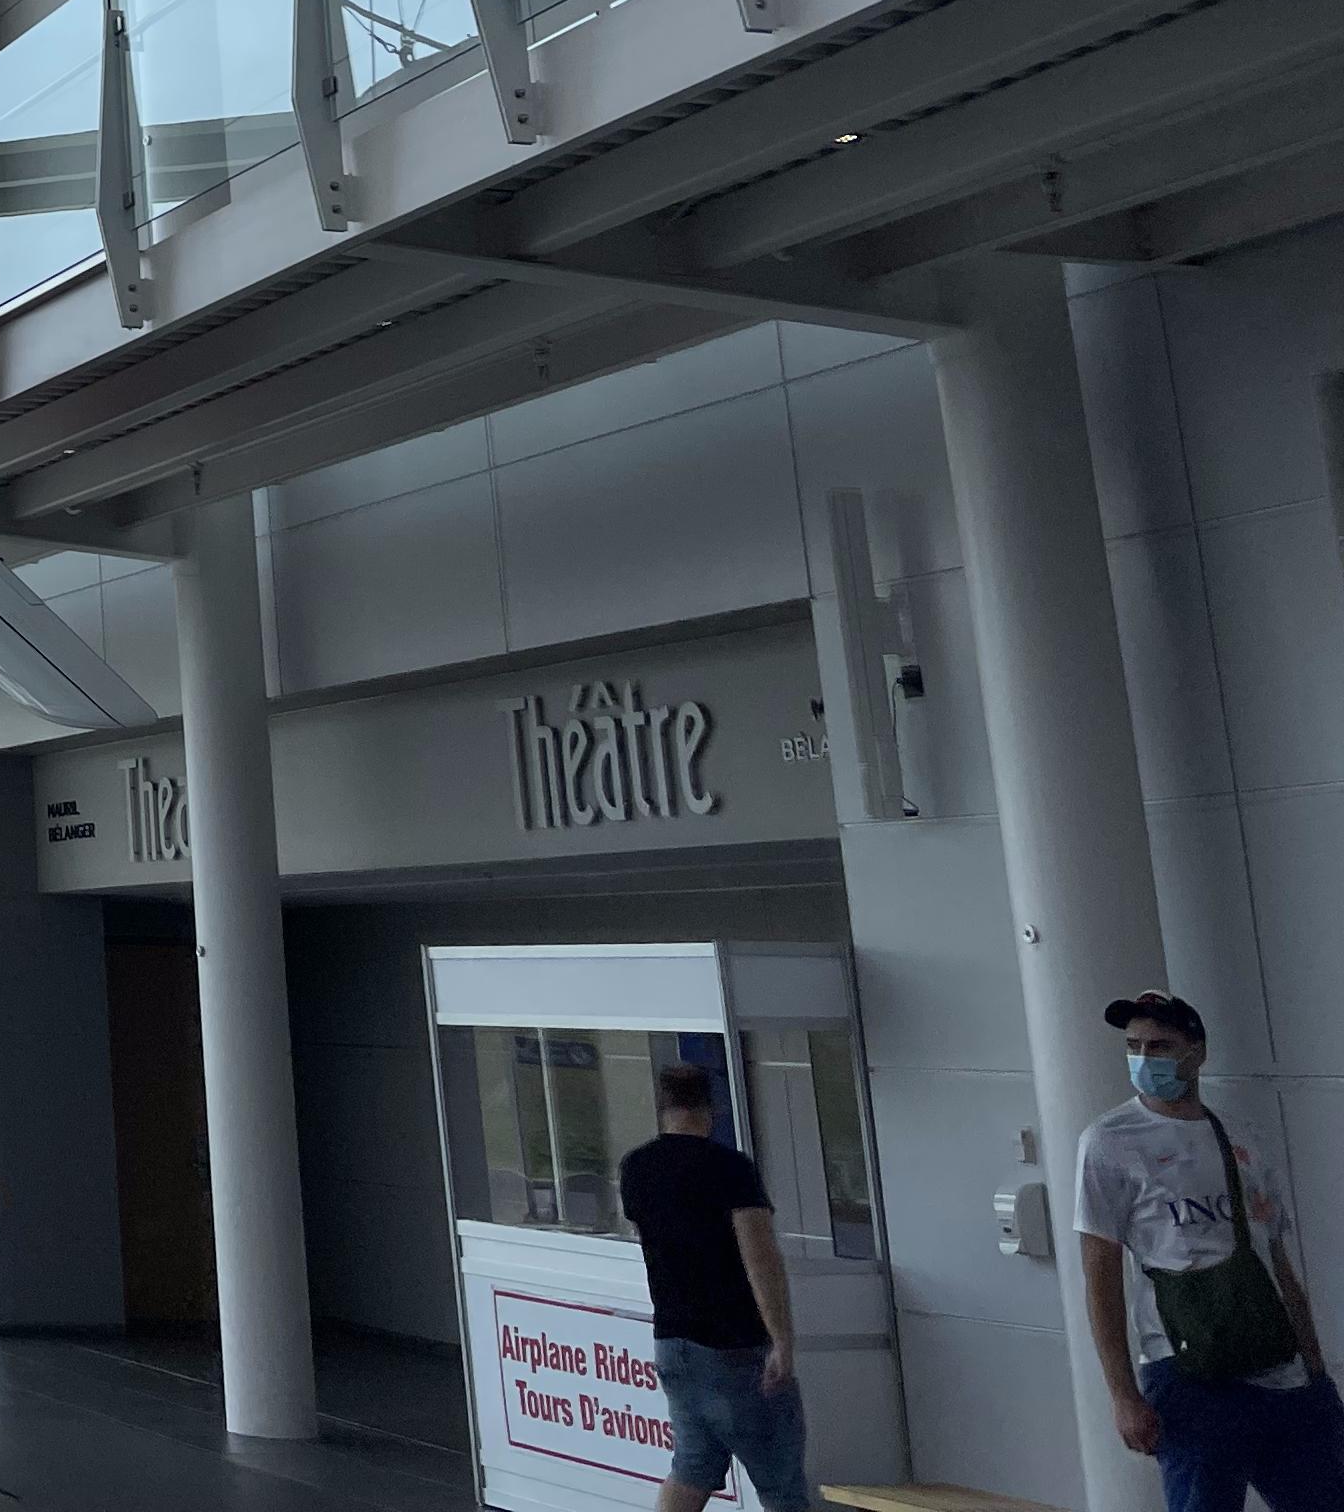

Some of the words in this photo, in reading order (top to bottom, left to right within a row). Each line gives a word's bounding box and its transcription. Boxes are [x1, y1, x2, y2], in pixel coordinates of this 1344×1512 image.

[493, 678, 714, 831] Théâtre
[780, 730, 832, 761] BÉLA
[48, 823, 96, 842] BÉLANGER
[116, 757, 193, 864] Thea
[502, 1324, 588, 1374] Airplane
[593, 1342, 658, 1391] Rides
[515, 1378, 574, 1427] Tours
[578, 1392, 675, 1452] D'avions
